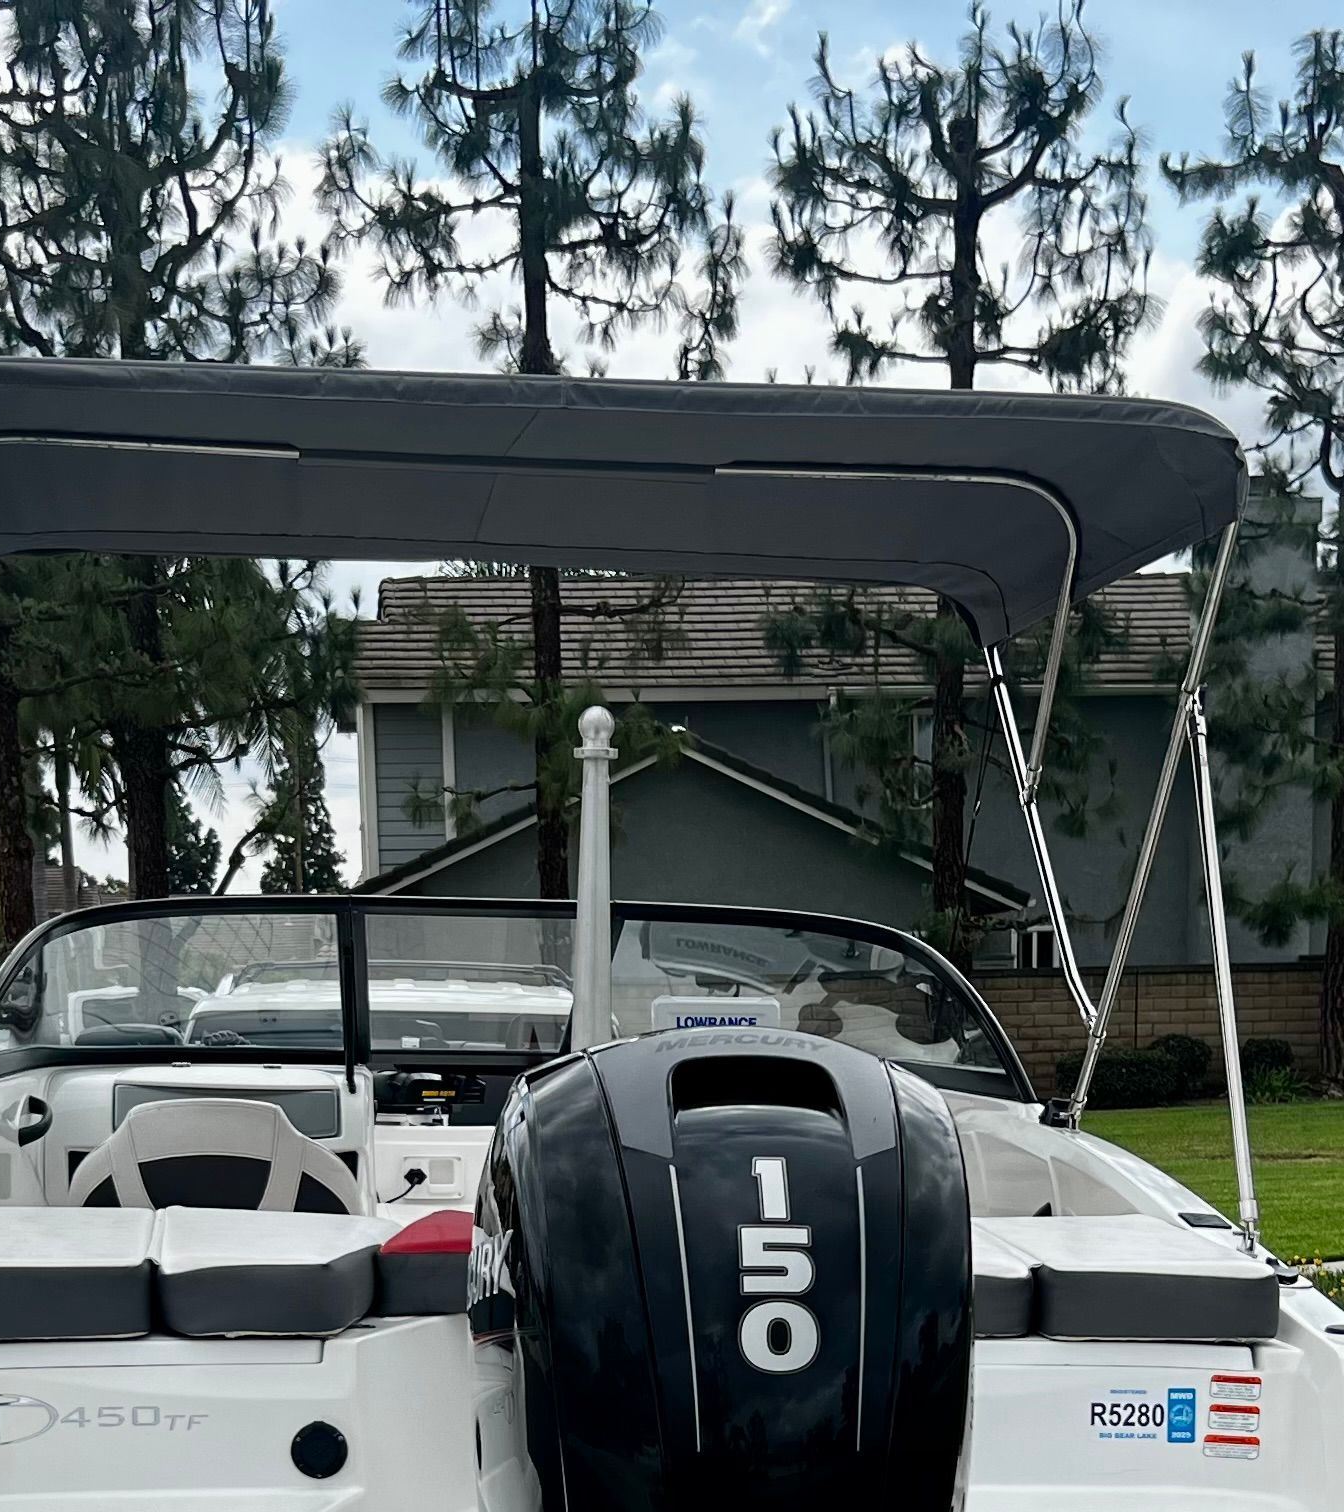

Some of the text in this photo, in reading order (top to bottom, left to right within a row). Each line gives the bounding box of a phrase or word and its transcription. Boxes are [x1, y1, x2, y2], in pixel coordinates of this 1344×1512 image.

[676, 1016, 758, 1030] LOWRANCE
[655, 1034, 829, 1053] MERCURY
[737, 1156, 823, 1376] 150
[1090, 1402, 1165, 1427] R5280
